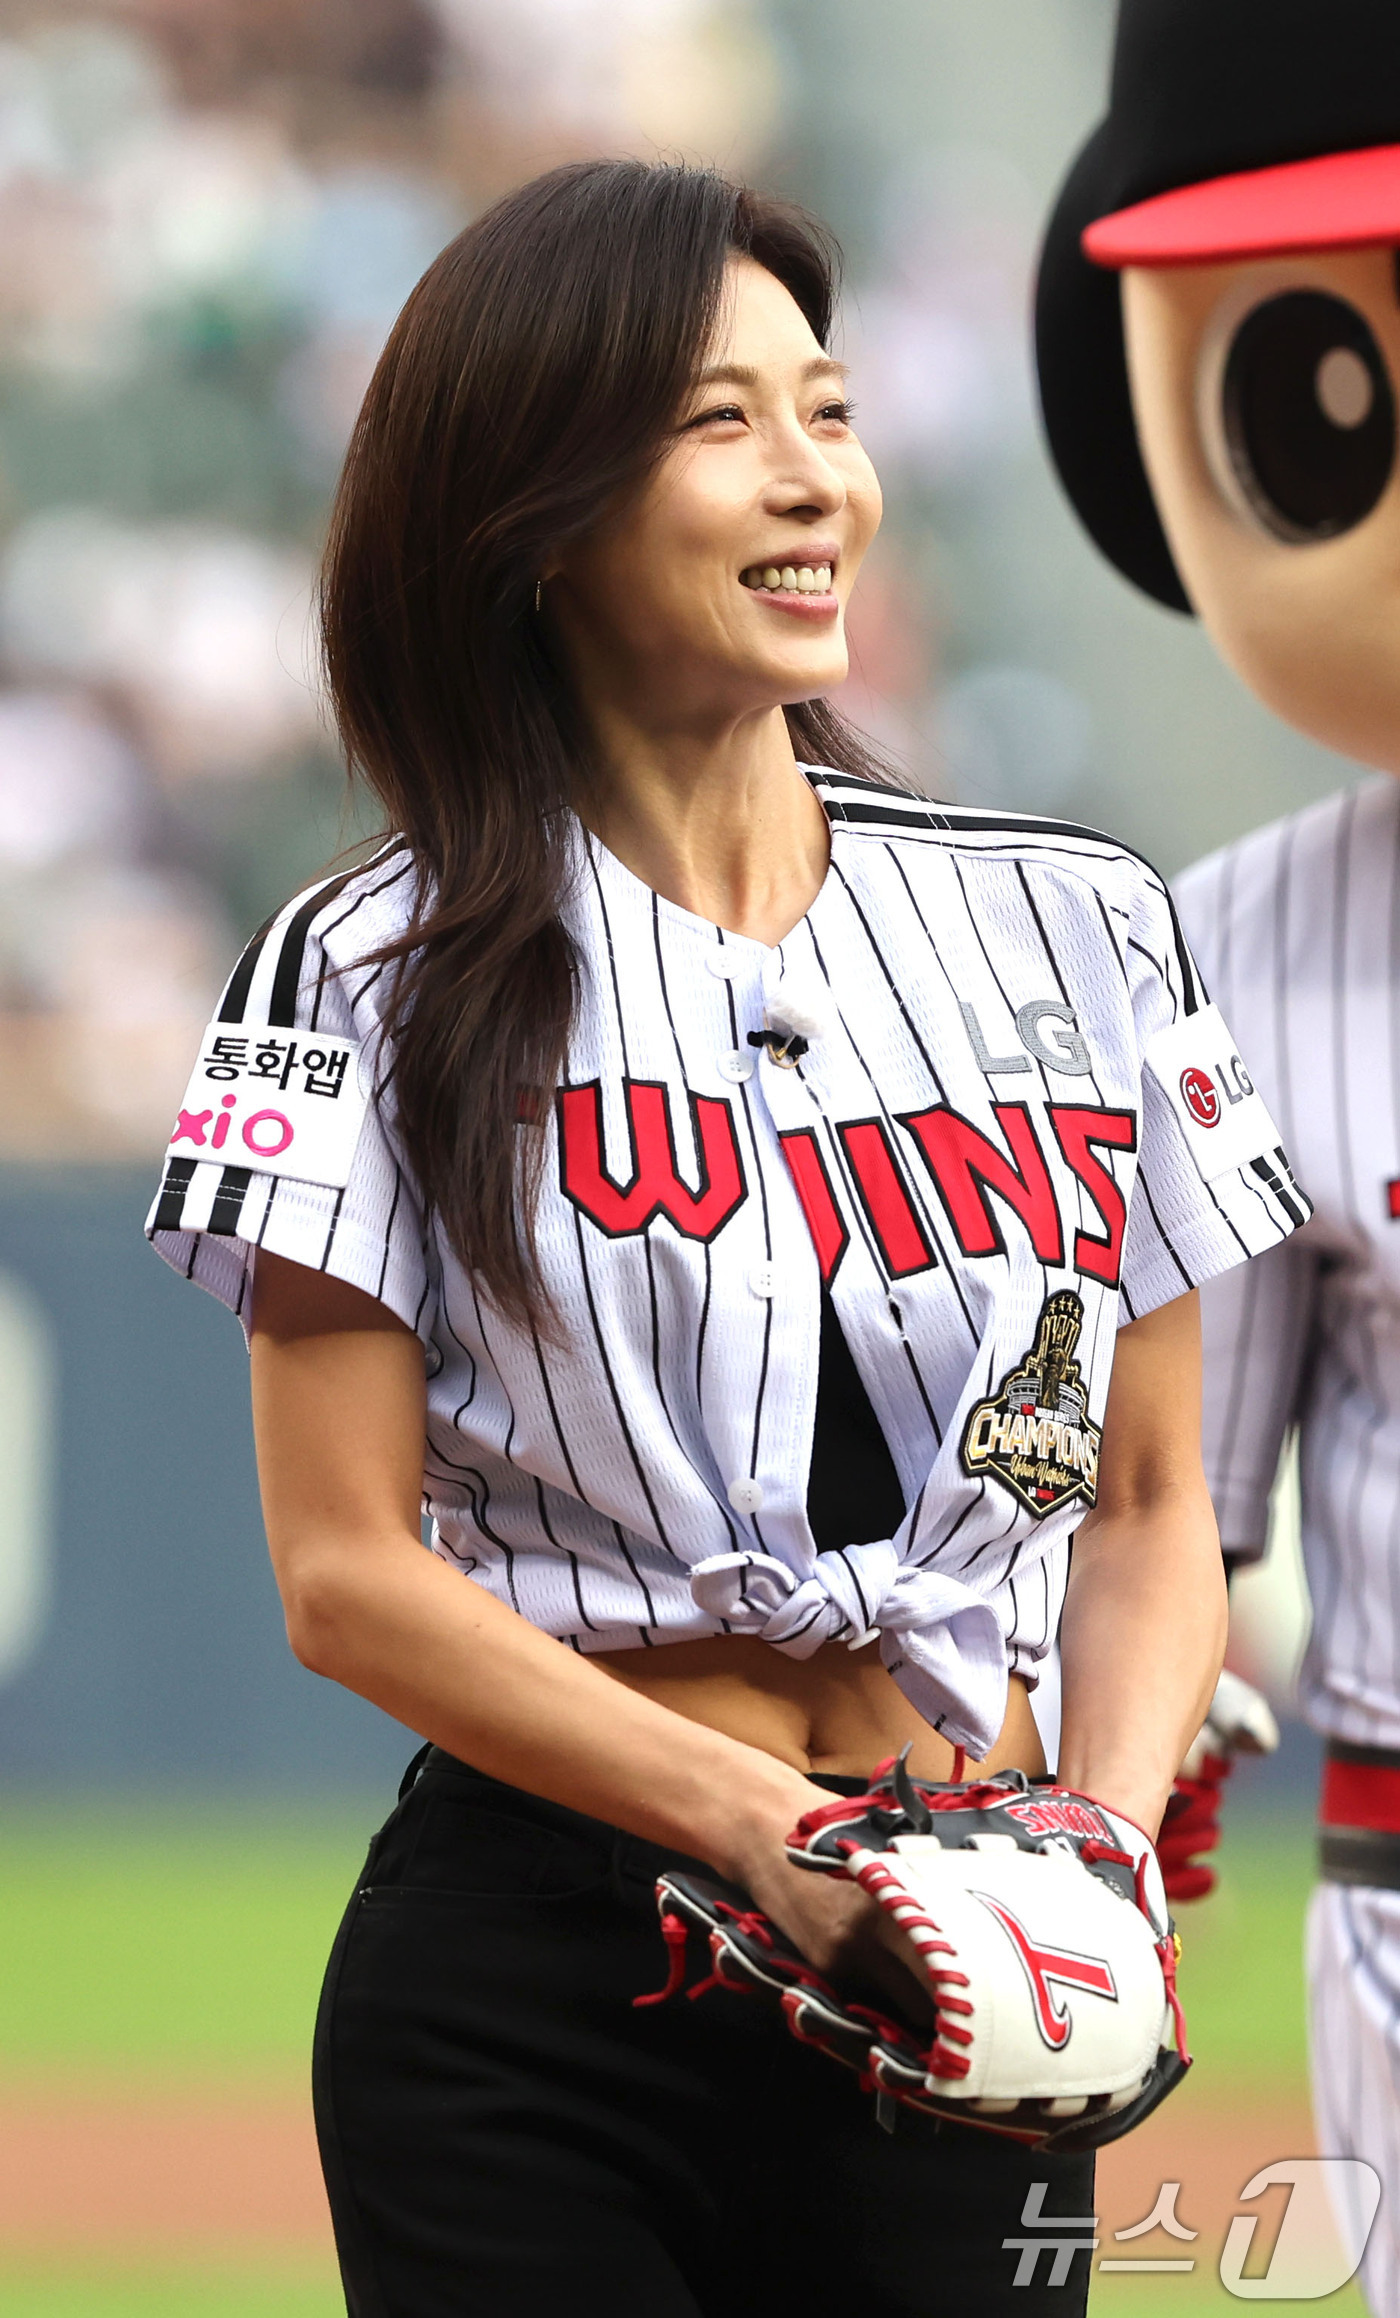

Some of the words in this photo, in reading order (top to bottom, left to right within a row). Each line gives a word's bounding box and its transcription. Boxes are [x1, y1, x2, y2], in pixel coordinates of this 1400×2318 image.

[204, 1036, 350, 1099] 통화앱
[959, 1000, 1093, 1076] LG
[1215, 1055, 1254, 1105] LG
[967, 1407, 1099, 1488] CHAMPIONS
